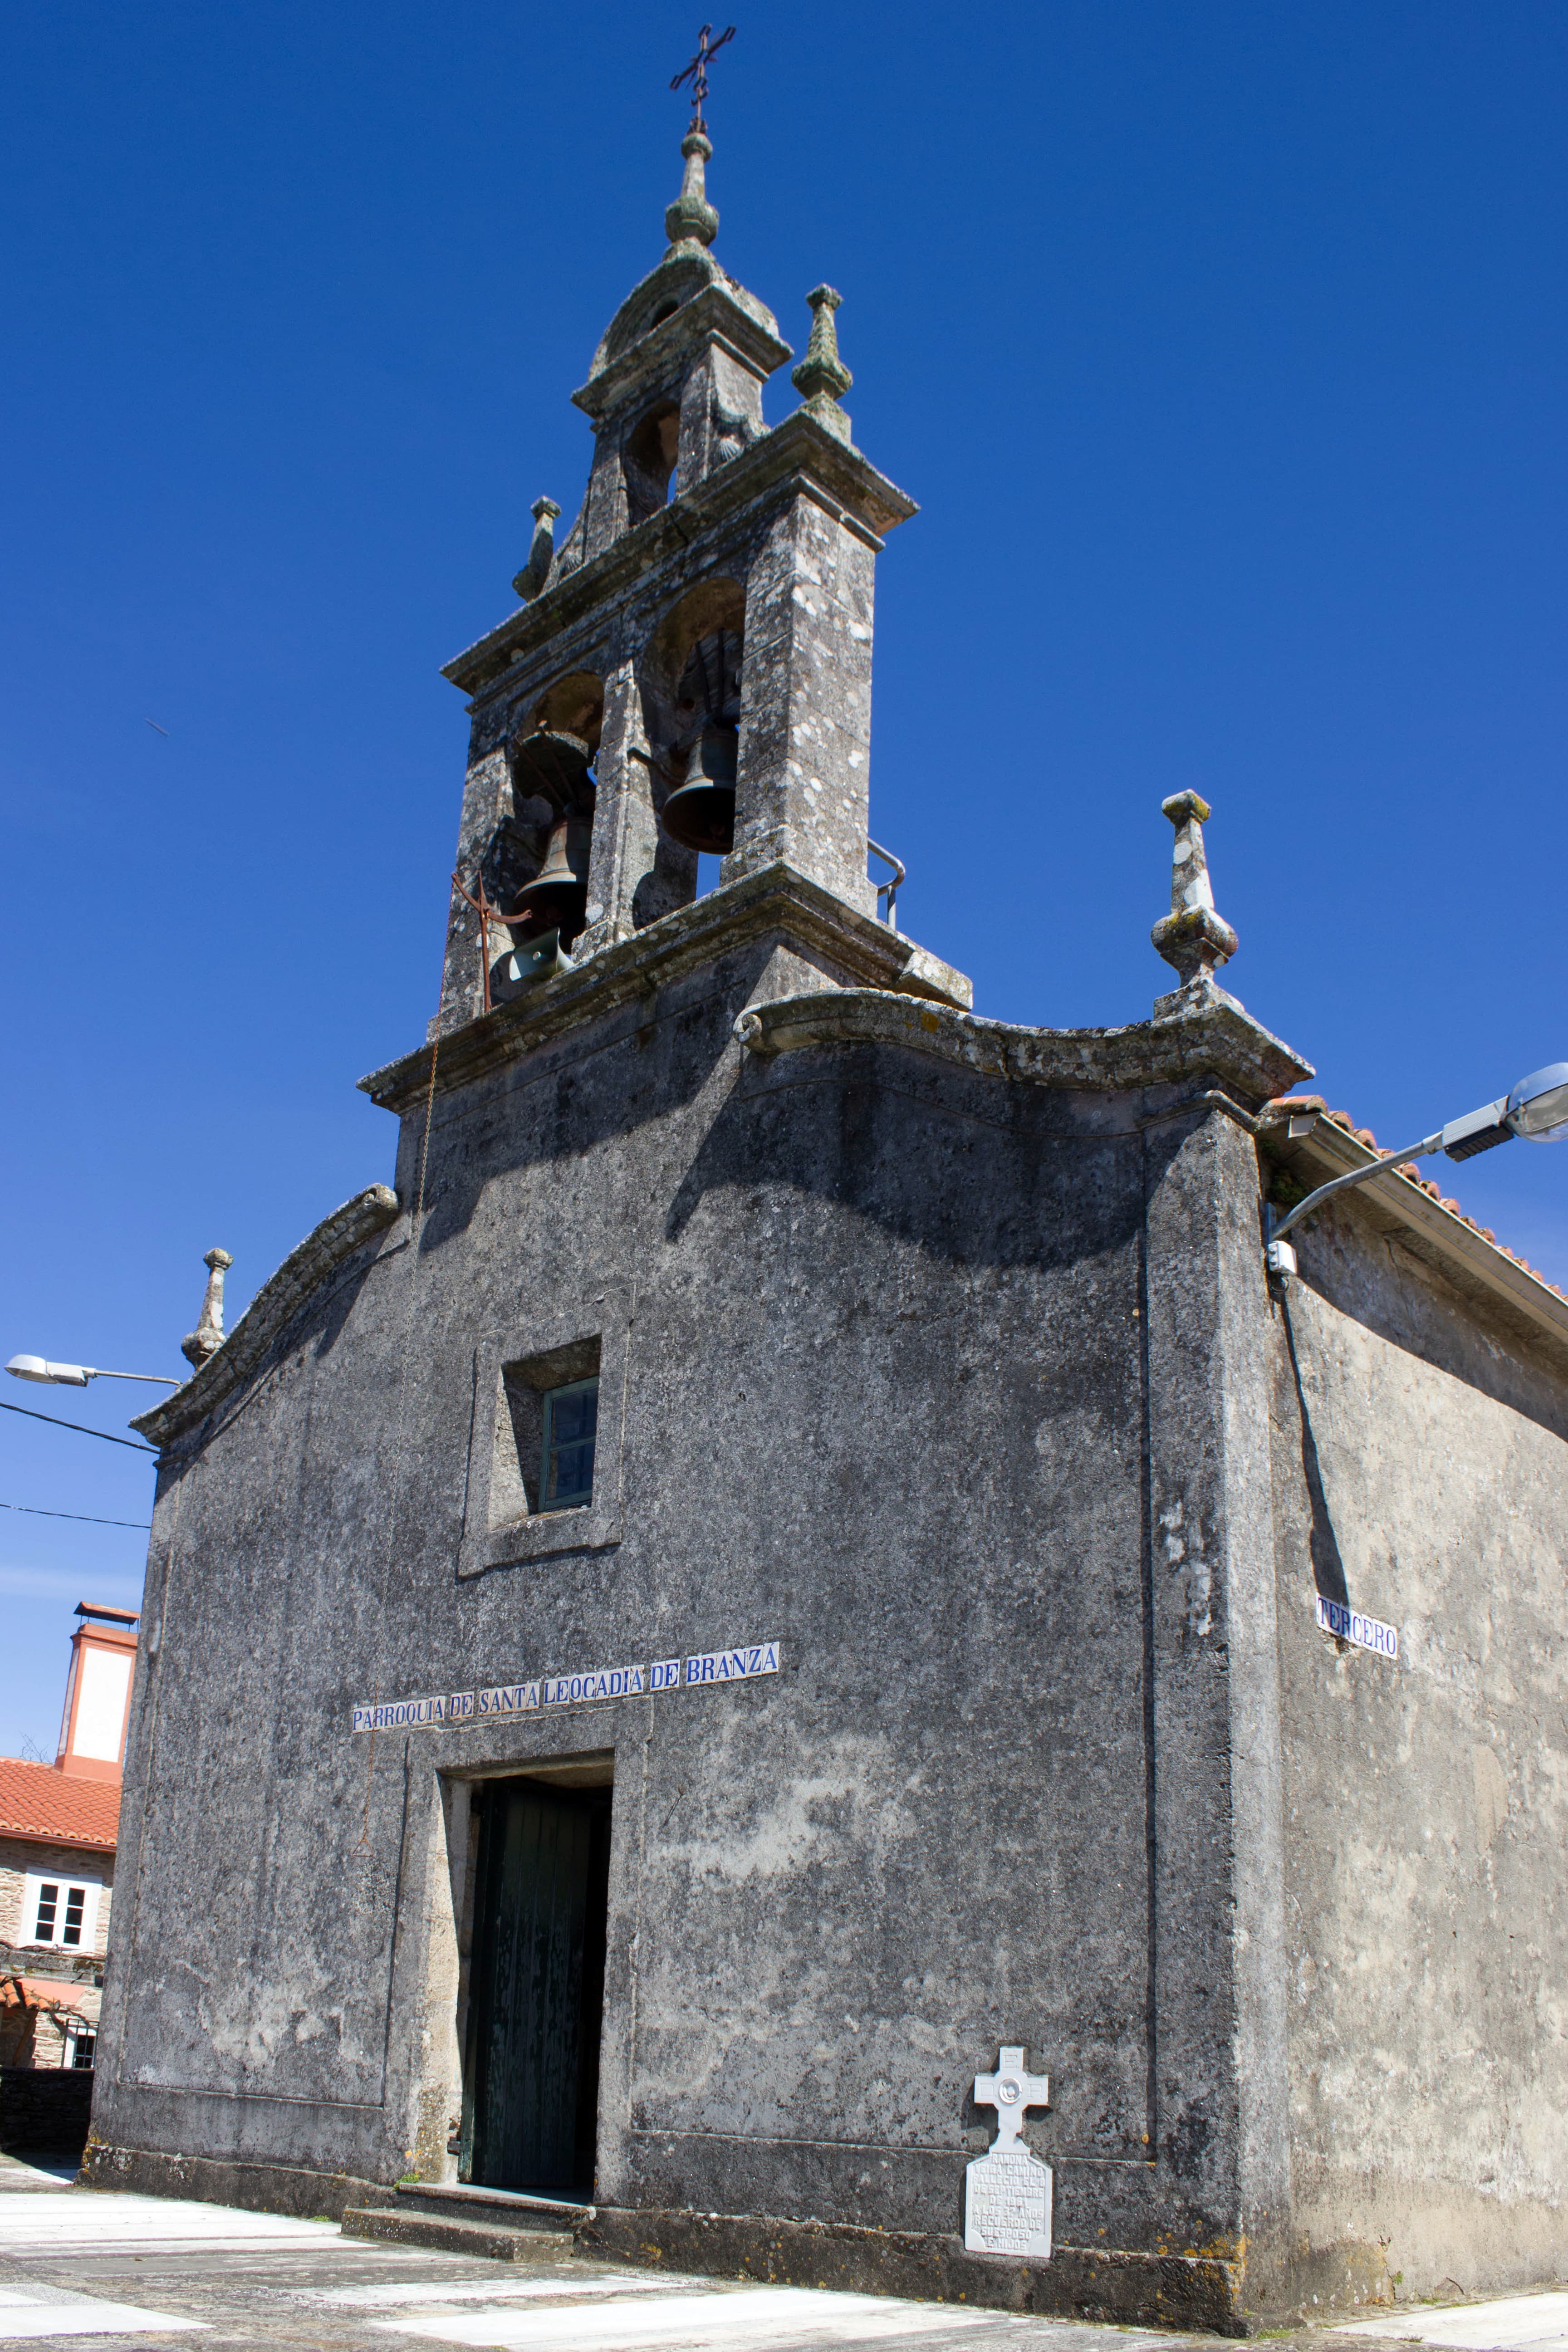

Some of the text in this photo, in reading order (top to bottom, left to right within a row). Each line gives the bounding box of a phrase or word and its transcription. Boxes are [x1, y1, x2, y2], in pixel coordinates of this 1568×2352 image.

[1318, 1597, 1396, 1655] TERCERO
[353, 1642, 777, 1730] PARROQUIA DE SANTA LEOCADIA DE BRANZÁ
[992, 2153, 1028, 2166] RAMONA
[975, 2164, 1044, 2177] VEIGA CAMINO
[1024, 2176, 1035, 2187] EL
[974, 2184, 1044, 2198] DE SEPTIEMBRE
[989, 2195, 1002, 2205] DE
[973, 2204, 979, 2215] A
[982, 2205, 1001, 2216] LOS
[974, 2215, 1042, 2230] RECUERDO DE
[987, 2237, 995, 2247] E
